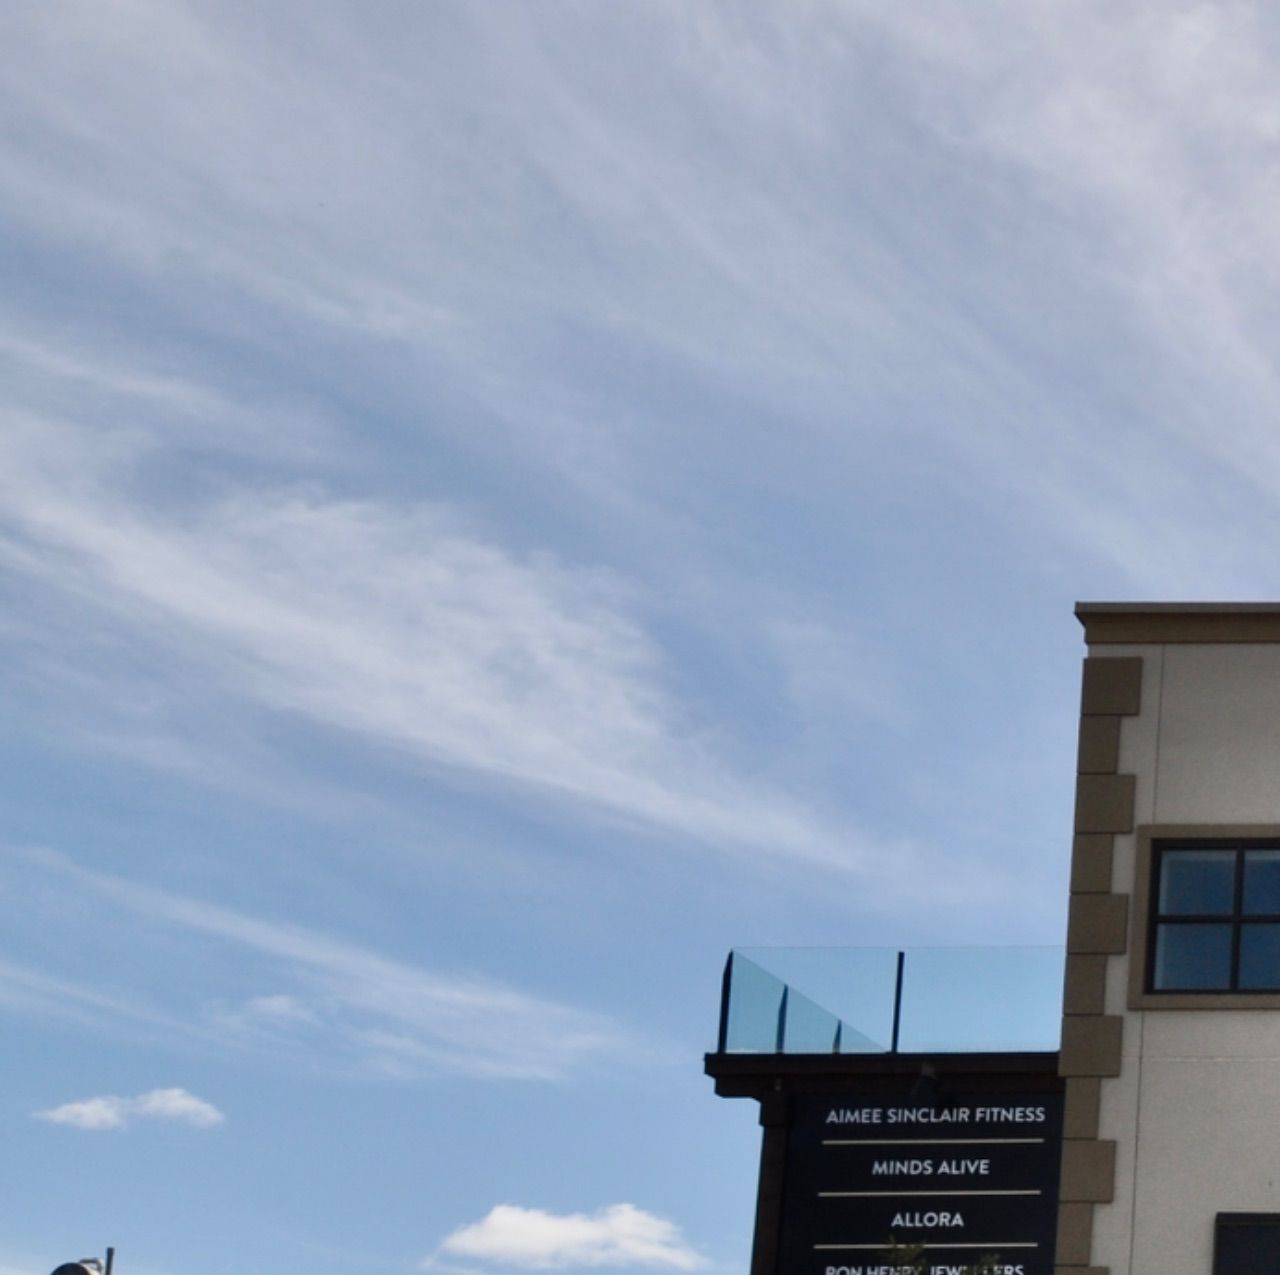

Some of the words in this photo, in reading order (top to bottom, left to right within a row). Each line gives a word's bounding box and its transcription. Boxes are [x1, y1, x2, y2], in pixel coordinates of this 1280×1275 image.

[826, 1109, 882, 1124] AIMEE
[887, 1107, 969, 1123] SINCLAIR
[975, 1107, 1046, 1122] FITNESS
[872, 1160, 933, 1176] MINDS
[938, 1159, 990, 1175] ALIVE
[891, 1212, 964, 1227] ALLORA
